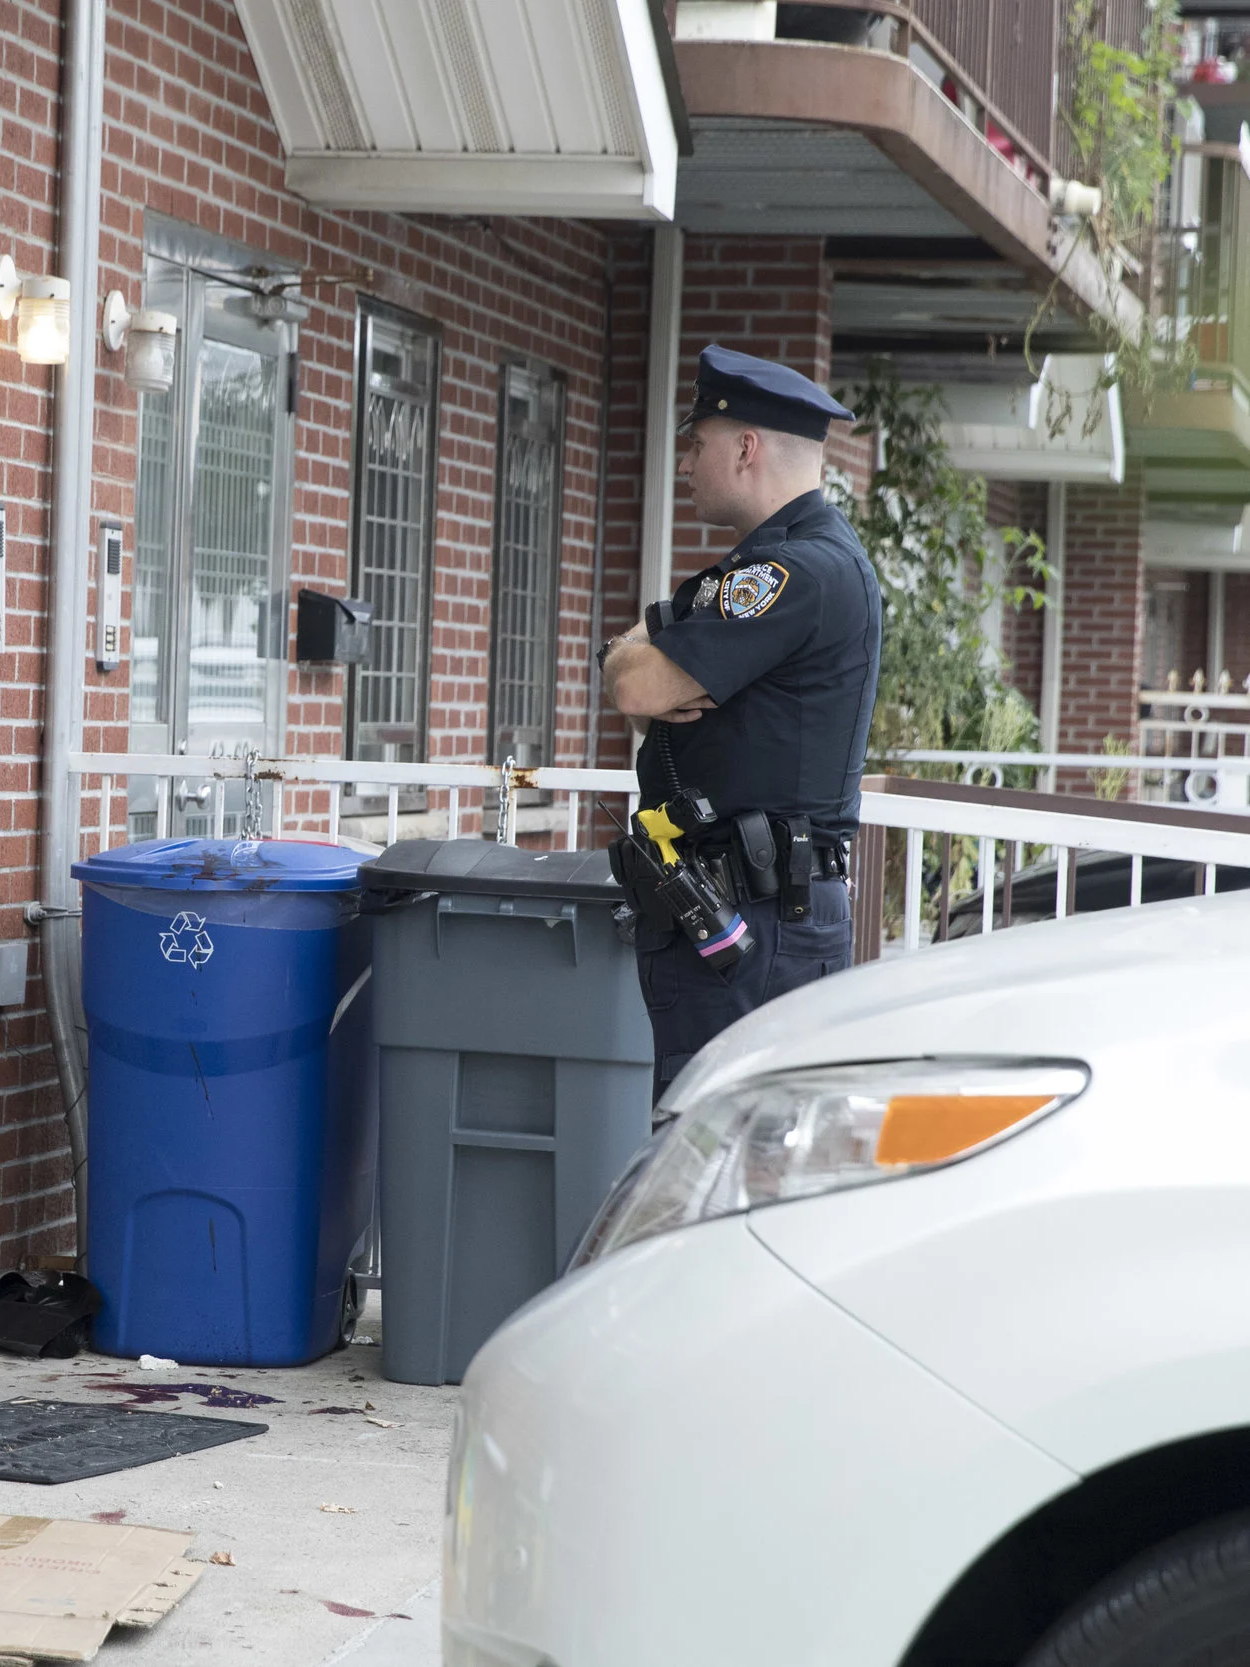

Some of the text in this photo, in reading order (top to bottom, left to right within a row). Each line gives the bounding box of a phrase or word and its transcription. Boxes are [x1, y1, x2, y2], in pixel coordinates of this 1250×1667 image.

[723, 600, 731, 611] OF
[755, 591, 775, 611] YORK
[2, 1555, 93, 1567] PRODUCT
